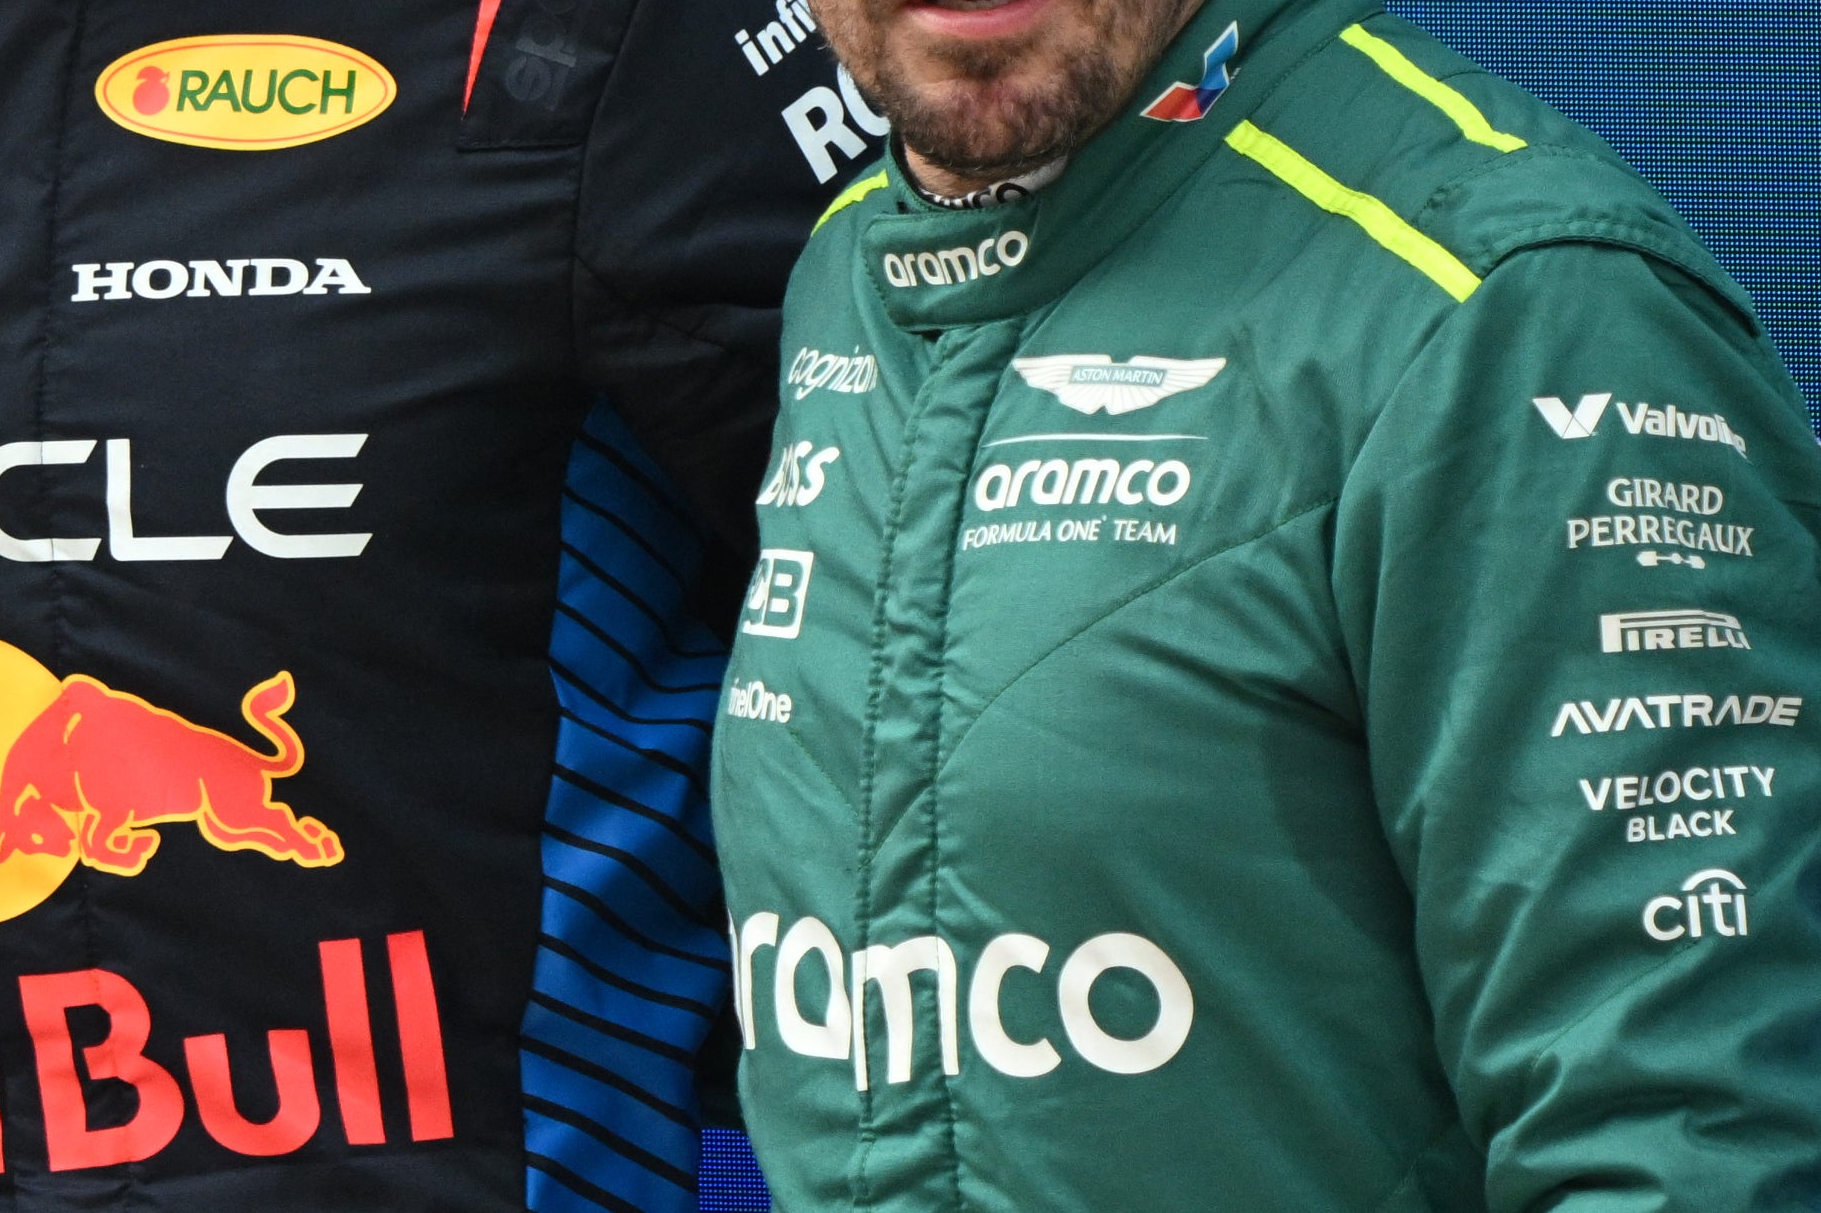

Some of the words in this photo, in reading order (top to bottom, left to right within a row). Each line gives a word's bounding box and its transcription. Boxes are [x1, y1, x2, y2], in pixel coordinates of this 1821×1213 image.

[176, 68, 357, 115] RAUCH
[70, 257, 372, 303] HONDA
[885, 230, 1029, 287] aramco
[1073, 368, 1113, 382] ASTON
[1113, 370, 1165, 385] MARTIN
[975, 458, 1191, 512] aramco
[1607, 478, 1724, 516] GIRARD
[962, 520, 1052, 551] FORMULA
[1114, 519, 1177, 546] TEAM
[1566, 514, 1755, 557] PERREGAUX
[1600, 609, 1752, 654] PIRELLI
[1551, 694, 1803, 737] AVATRADE
[1580, 765, 1776, 812] VELOCITY
[1626, 809, 1736, 843] BLACK
[1642, 868, 1748, 942] citi
[728, 910, 1194, 1093] ramco
[18, 929, 454, 1173] Bull
